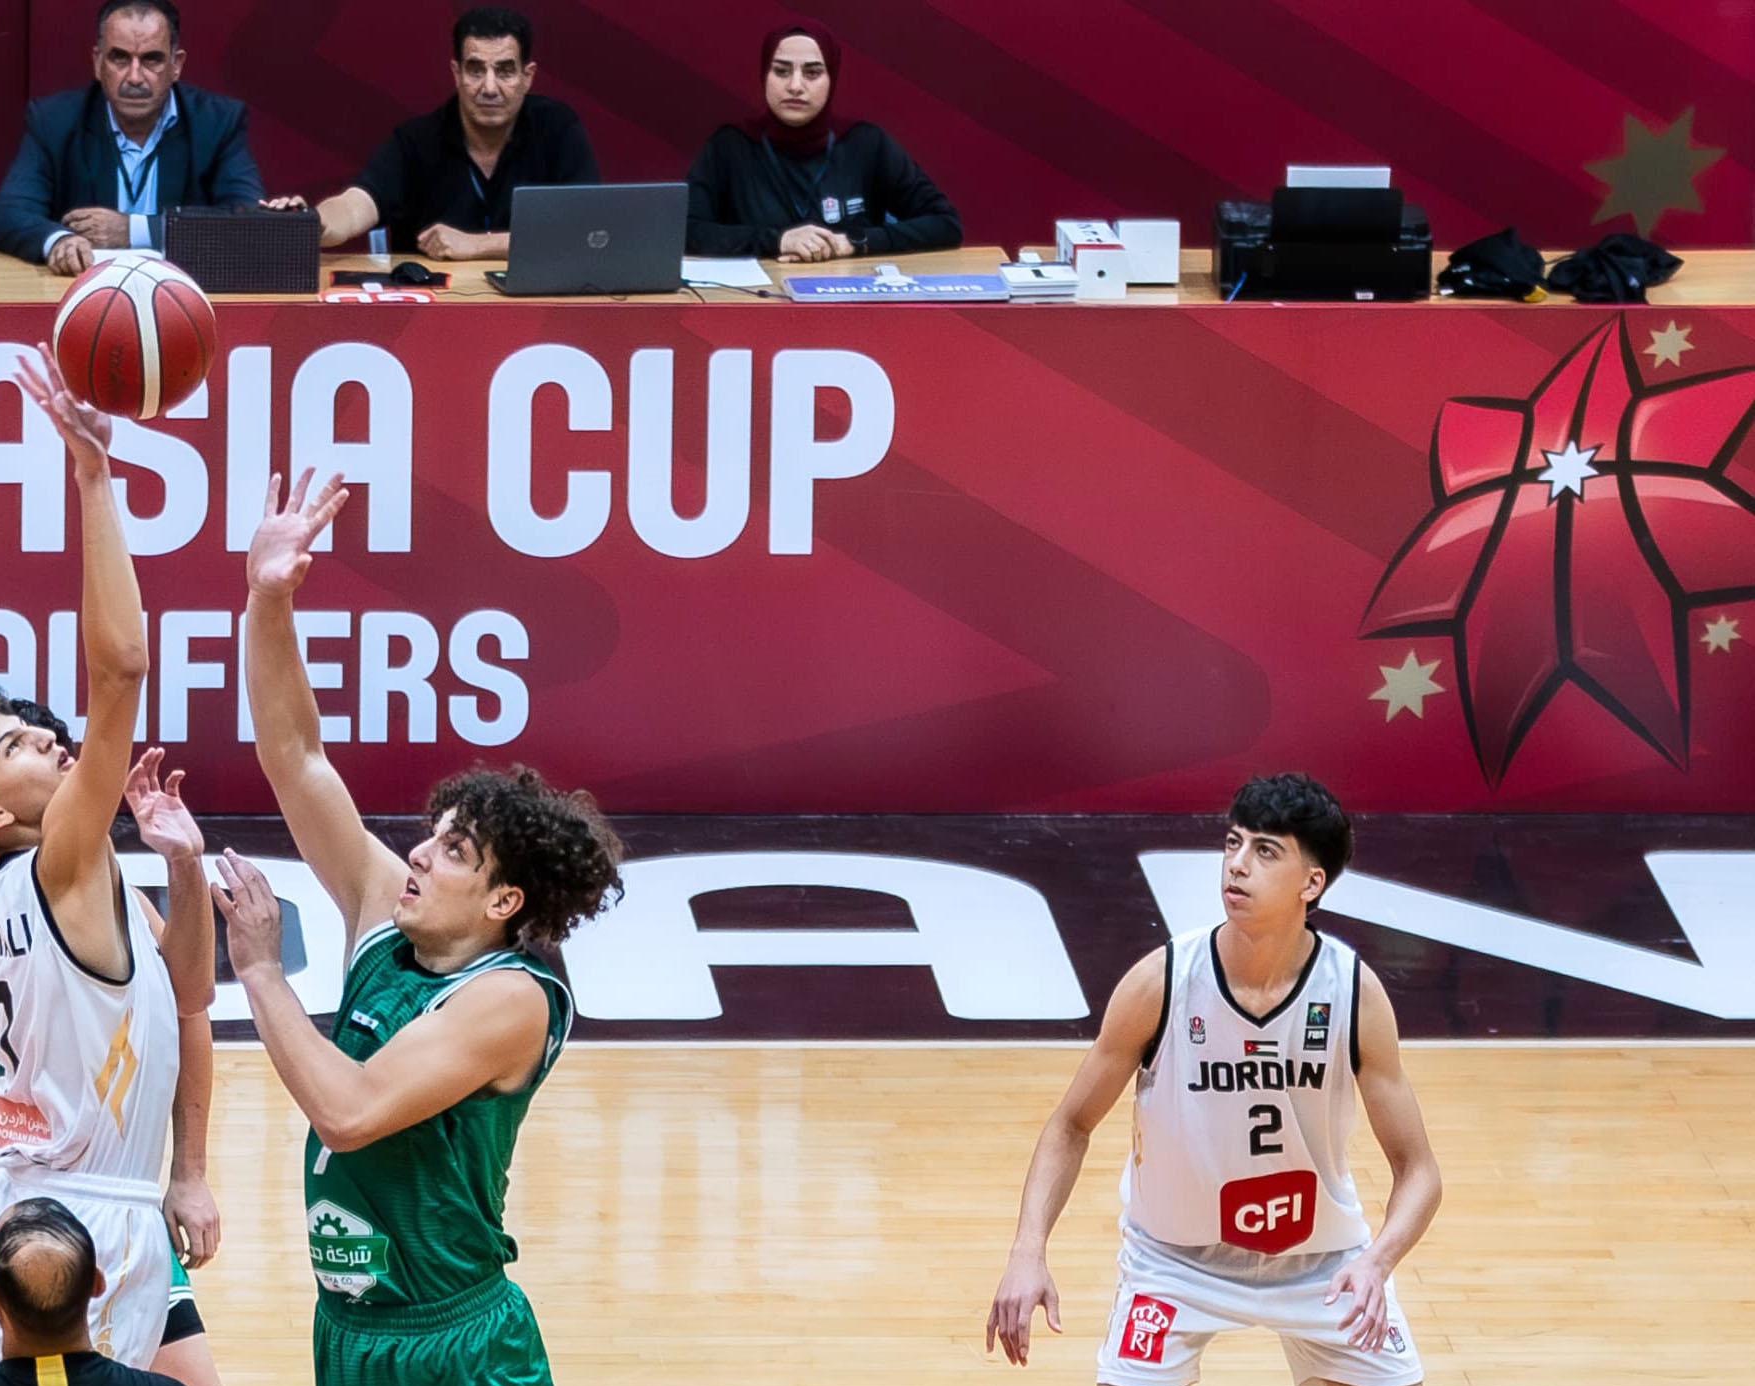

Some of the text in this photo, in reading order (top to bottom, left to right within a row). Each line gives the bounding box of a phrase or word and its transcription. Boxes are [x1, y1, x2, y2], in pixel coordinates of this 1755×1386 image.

[815, 283, 985, 295] SUBSTITUTION
[487, 343, 895, 558] CUP
[1248, 1104, 1283, 1156] 2
[1234, 1192, 1302, 1233] CFI
[326, 1245, 371, 1267] شركة
[1129, 1330, 1154, 1359] RJ
